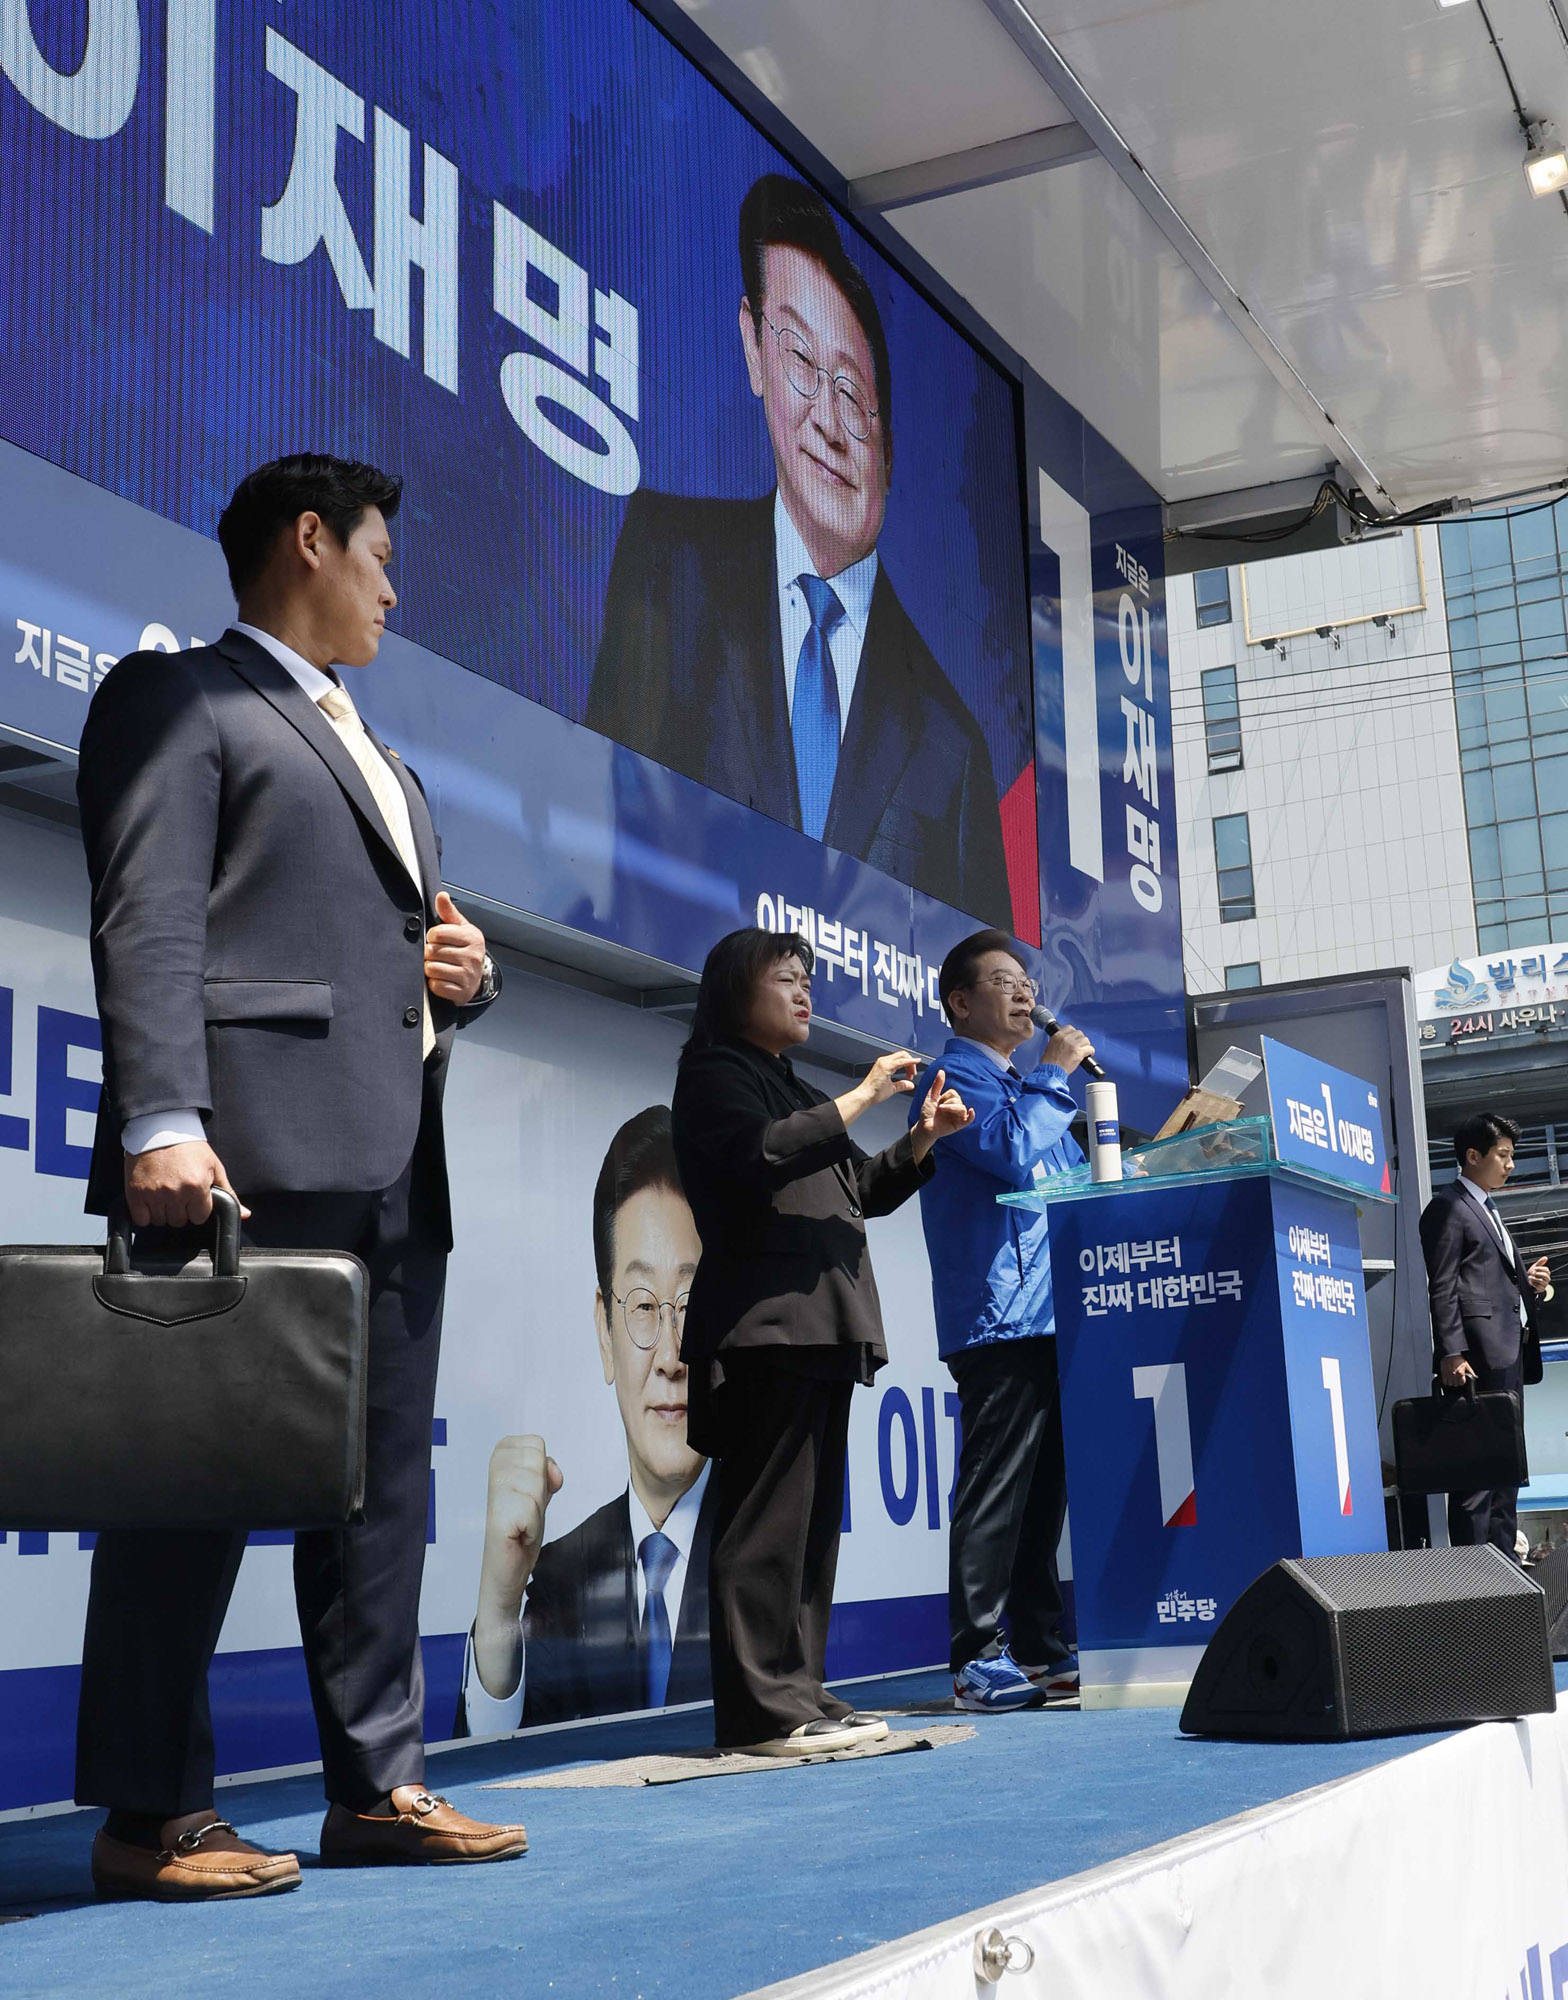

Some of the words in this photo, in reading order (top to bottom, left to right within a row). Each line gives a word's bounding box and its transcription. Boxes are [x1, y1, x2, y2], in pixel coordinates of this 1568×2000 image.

[0, 0, 640, 496] 이재명
[1114, 542, 1150, 598] 지금은
[1038, 466, 1104, 884] 1
[1117, 592, 1163, 913] 이재명
[873, 940, 924, 1017] 진짜
[1499, 985, 1568, 1007] FITN
[1450, 1013, 1494, 1036] 24시
[1499, 1004, 1557, 1029] 사우나
[1286, 1098, 1328, 1149] 지금은
[1321, 1083, 1338, 1152] 1
[1338, 1119, 1375, 1165] 이재명
[1079, 1236, 1182, 1277] 이제부터
[1288, 1225, 1332, 1269] 이제부터
[1081, 1281, 1134, 1317] 진짜
[1137, 1270, 1243, 1310] 대한민국
[1291, 1270, 1316, 1309] 진짜
[1315, 1274, 1356, 1316] 대한민국
[1132, 1362, 1198, 1528] 1
[1321, 1356, 1353, 1516] 1
[1157, 1598, 1217, 1623] 민주당
[1164, 1589, 1187, 1602] 더불어
